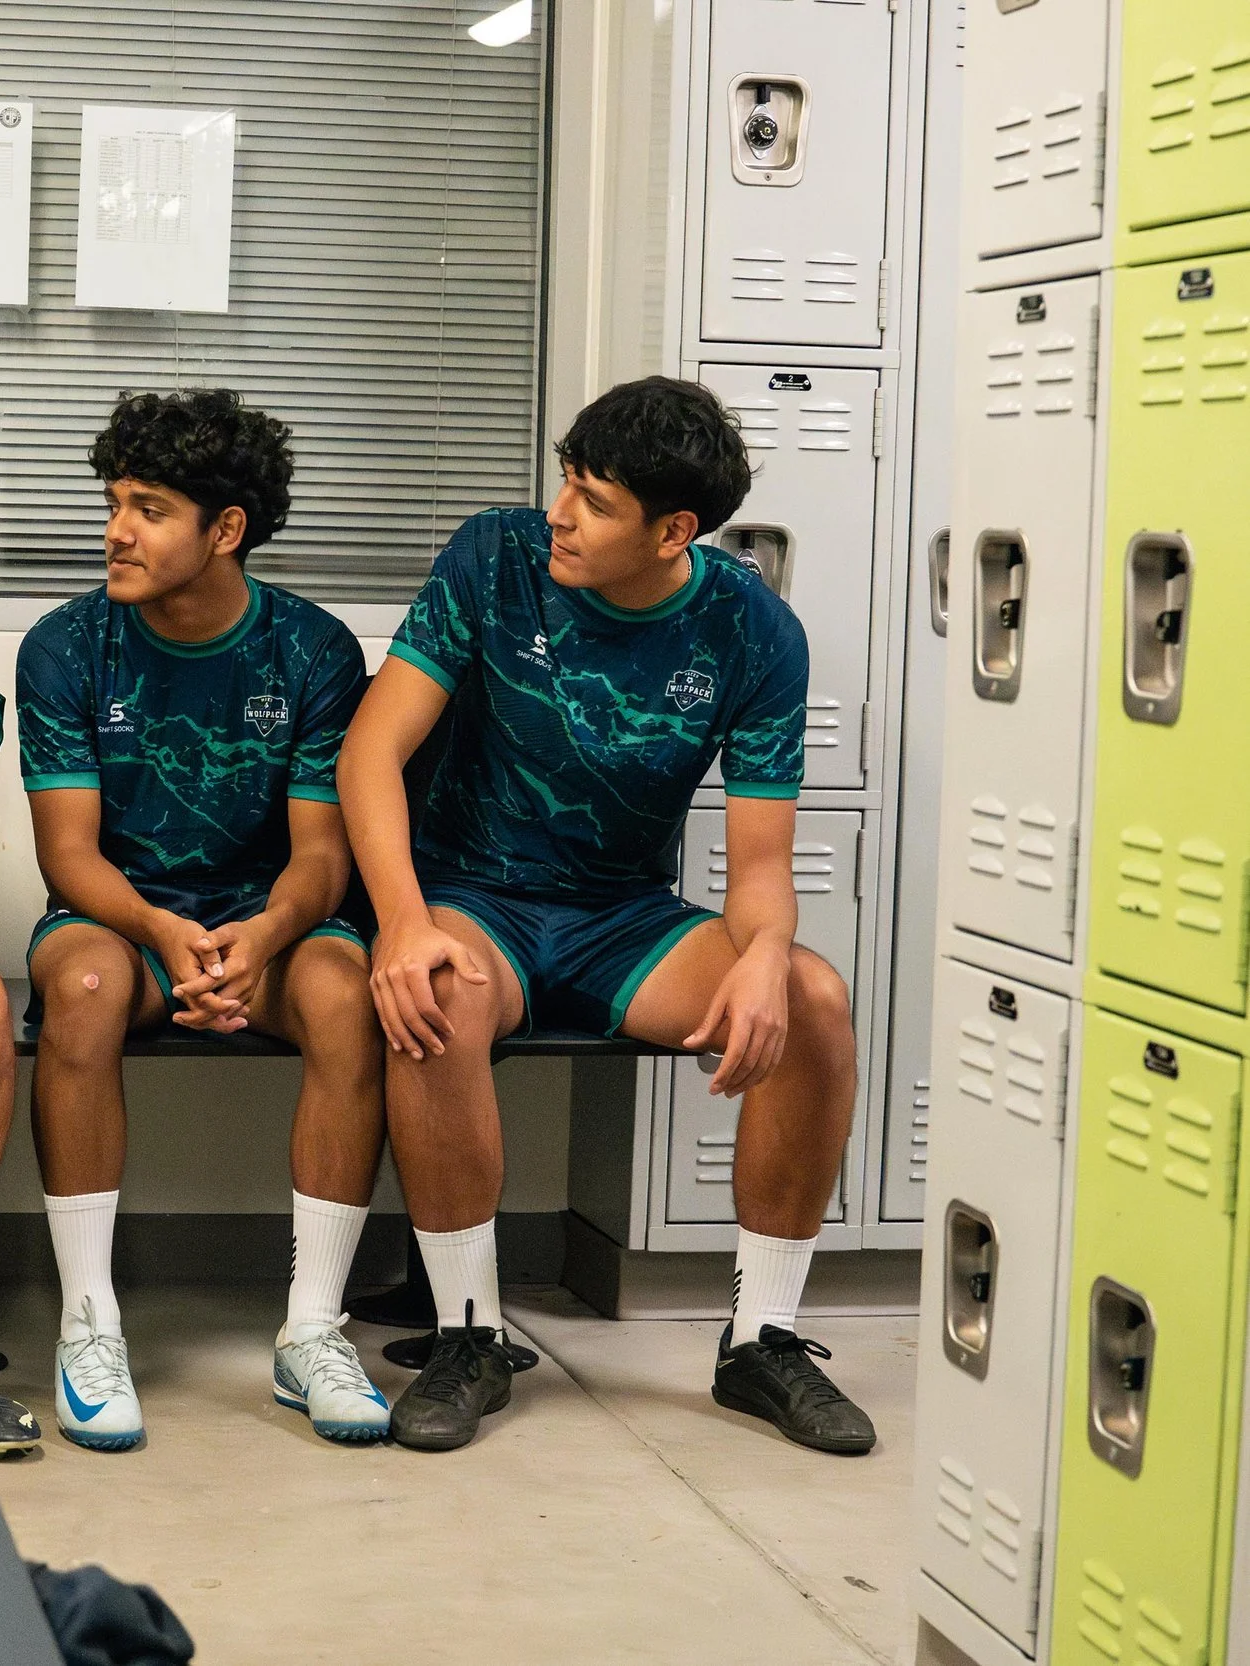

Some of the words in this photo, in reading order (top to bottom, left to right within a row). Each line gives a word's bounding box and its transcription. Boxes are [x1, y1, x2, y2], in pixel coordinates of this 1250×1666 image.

[515, 648, 536, 663] SHIFT
[246, 709, 287, 720] WOLFPACK
[97, 725, 114, 733] SHIFT
[113, 725, 135, 733] SOCKS
